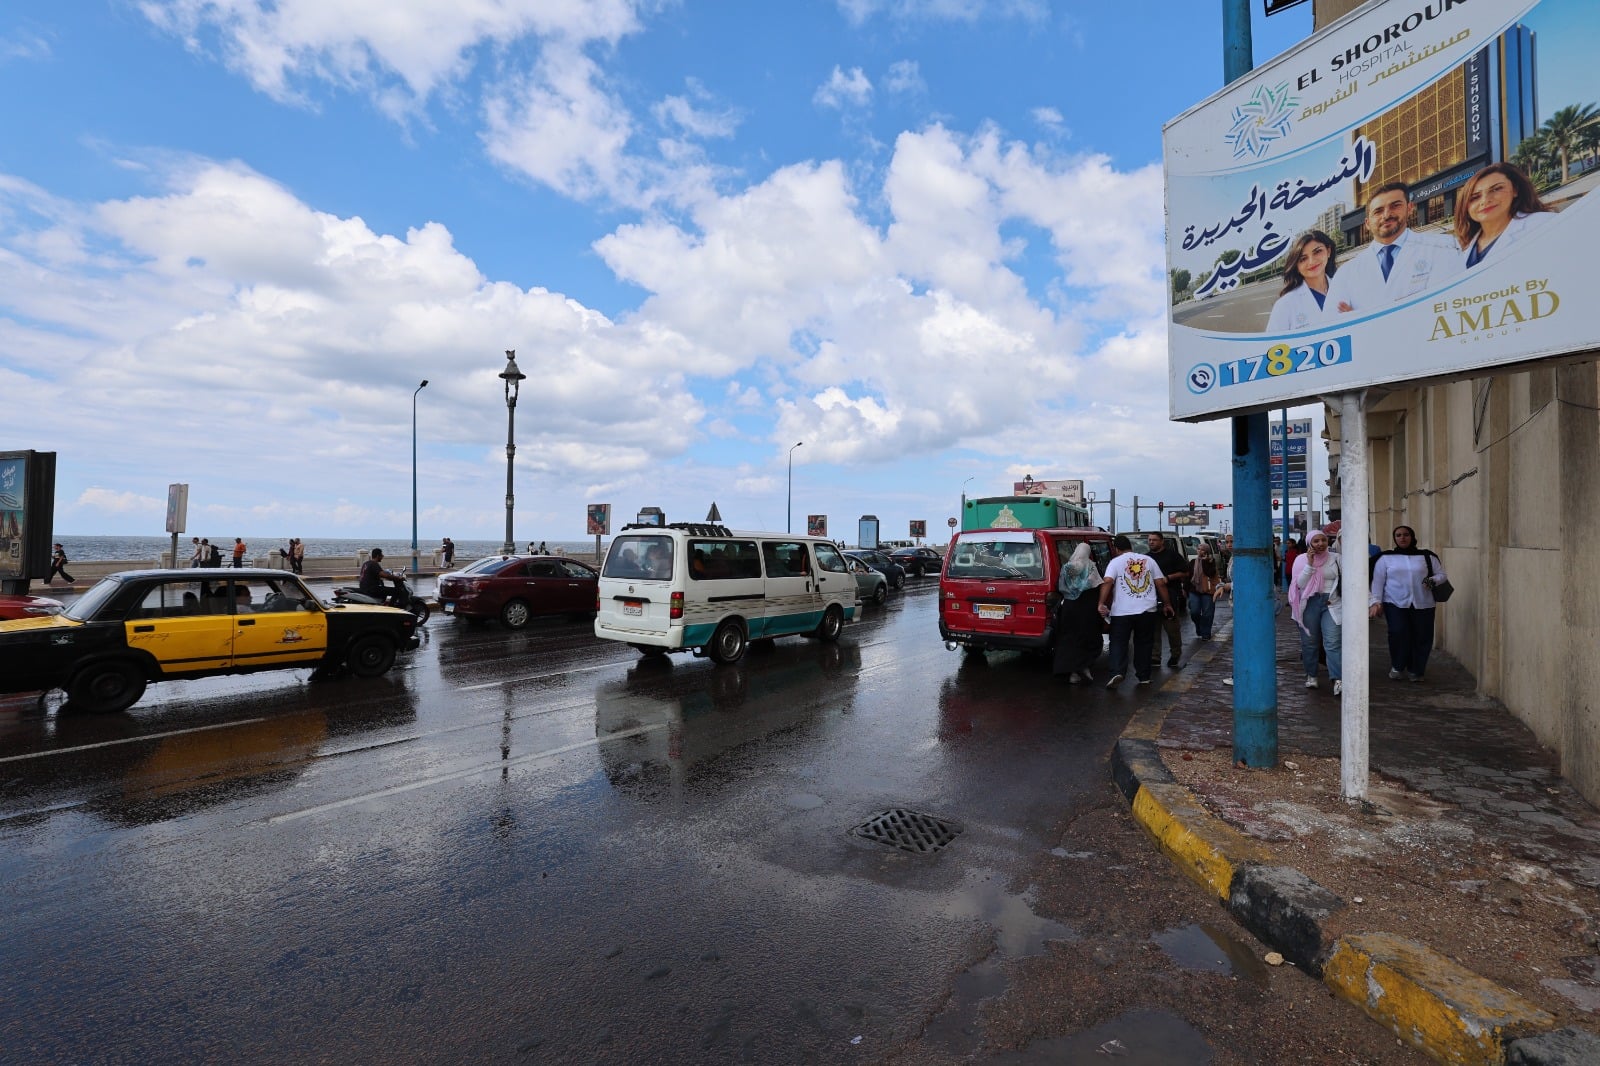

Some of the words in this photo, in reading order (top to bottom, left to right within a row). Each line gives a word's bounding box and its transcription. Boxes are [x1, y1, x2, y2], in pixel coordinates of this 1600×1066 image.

[1297, 68, 1323, 91] EL
[1339, 40, 1414, 84] HOSPITAL
[1367, 28, 1470, 86] مستشفى
[1470, 74, 1480, 143] SHOROUK
[1269, 139, 1372, 211] النسخة
[1182, 185, 1266, 251] الجديدة
[1427, 290, 1561, 342] AMAD
[1433, 302, 1448, 314] El
[1452, 284, 1521, 309] Shorouk
[1525, 278, 1549, 292] By
[1460, 327, 1522, 344] GROUP
[1226, 339, 1341, 385] 17820
[1271, 423, 1310, 435] Mobil
